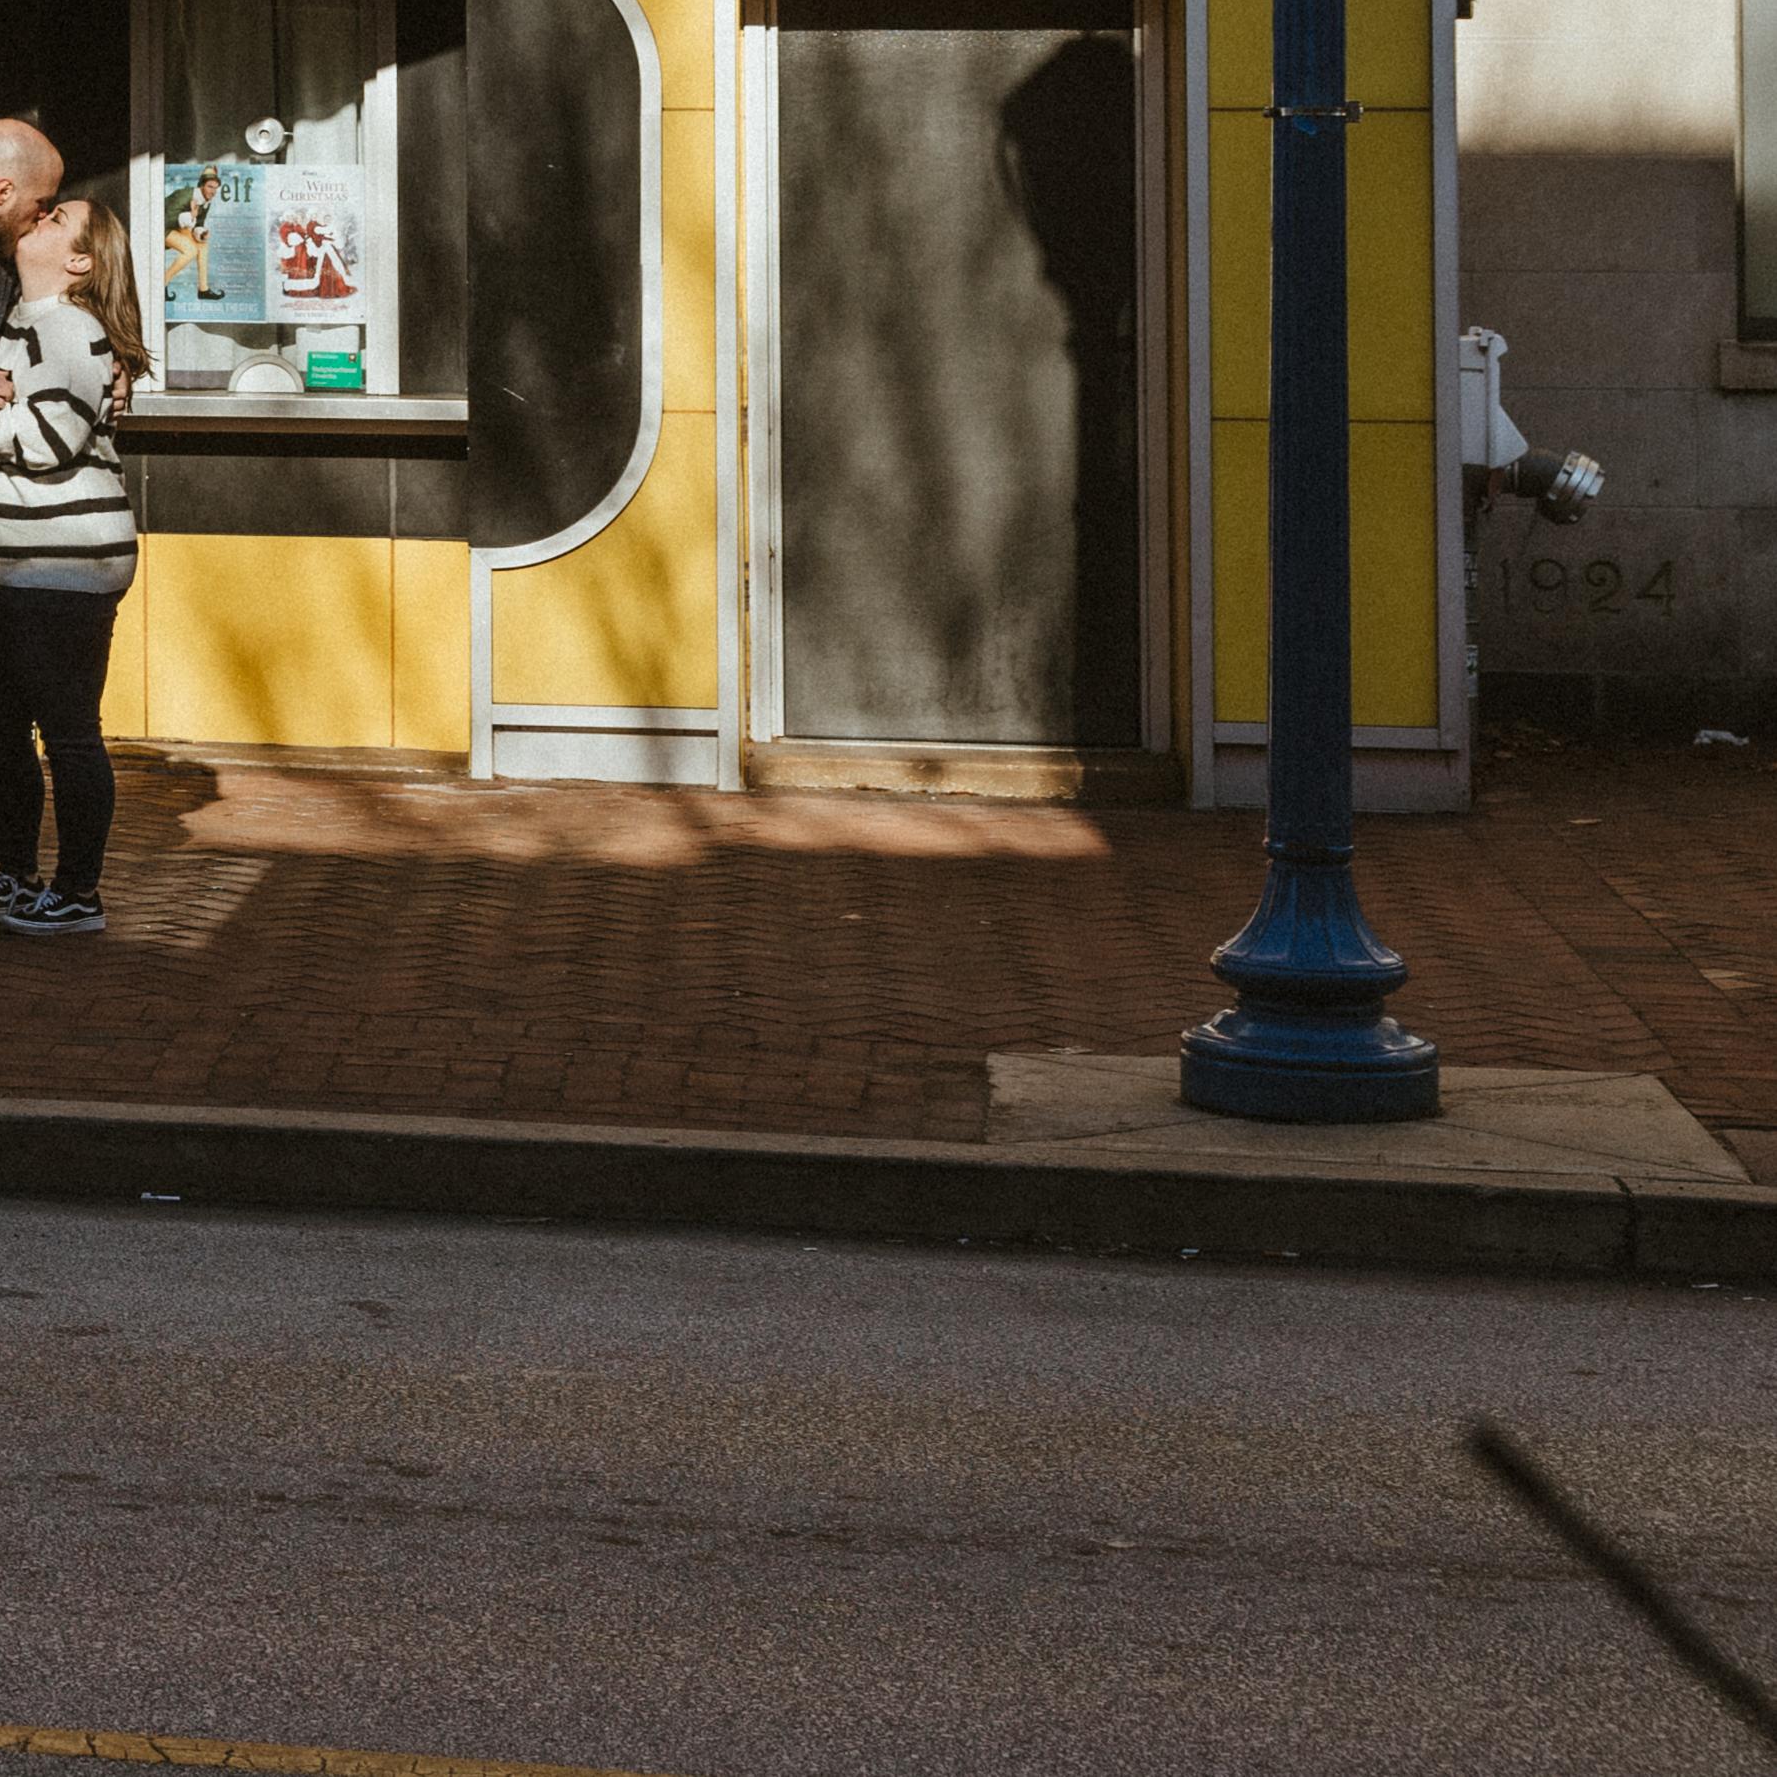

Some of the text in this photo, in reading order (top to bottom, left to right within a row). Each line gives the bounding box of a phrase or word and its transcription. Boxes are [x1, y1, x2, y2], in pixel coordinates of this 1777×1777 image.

[220, 176, 255, 204] elf
[279, 189, 349, 202] CHRISTMAS
[306, 180, 348, 192] WHITE
[1498, 557, 1679, 618] 1924
